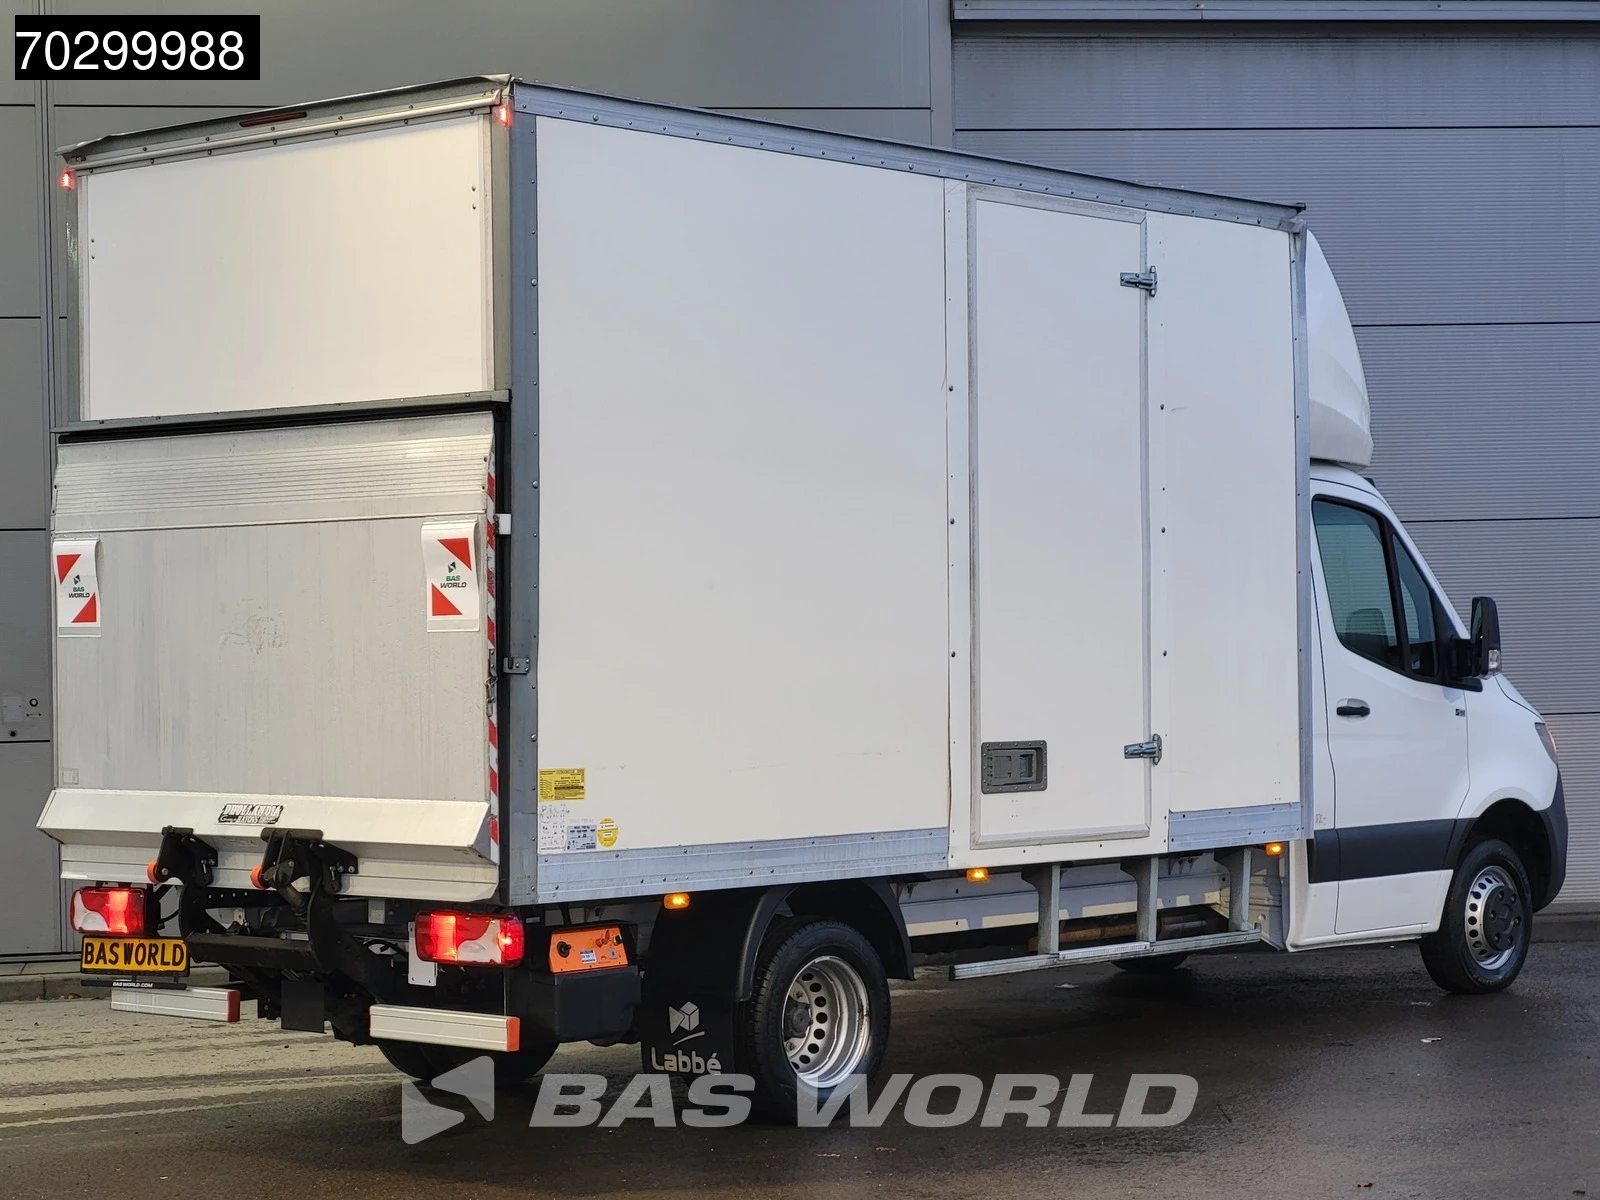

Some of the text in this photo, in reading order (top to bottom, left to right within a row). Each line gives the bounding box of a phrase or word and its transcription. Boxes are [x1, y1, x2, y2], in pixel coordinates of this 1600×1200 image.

[84, 942, 185, 967] BAS WORLD
[651, 1047, 722, 1076] Labbé
